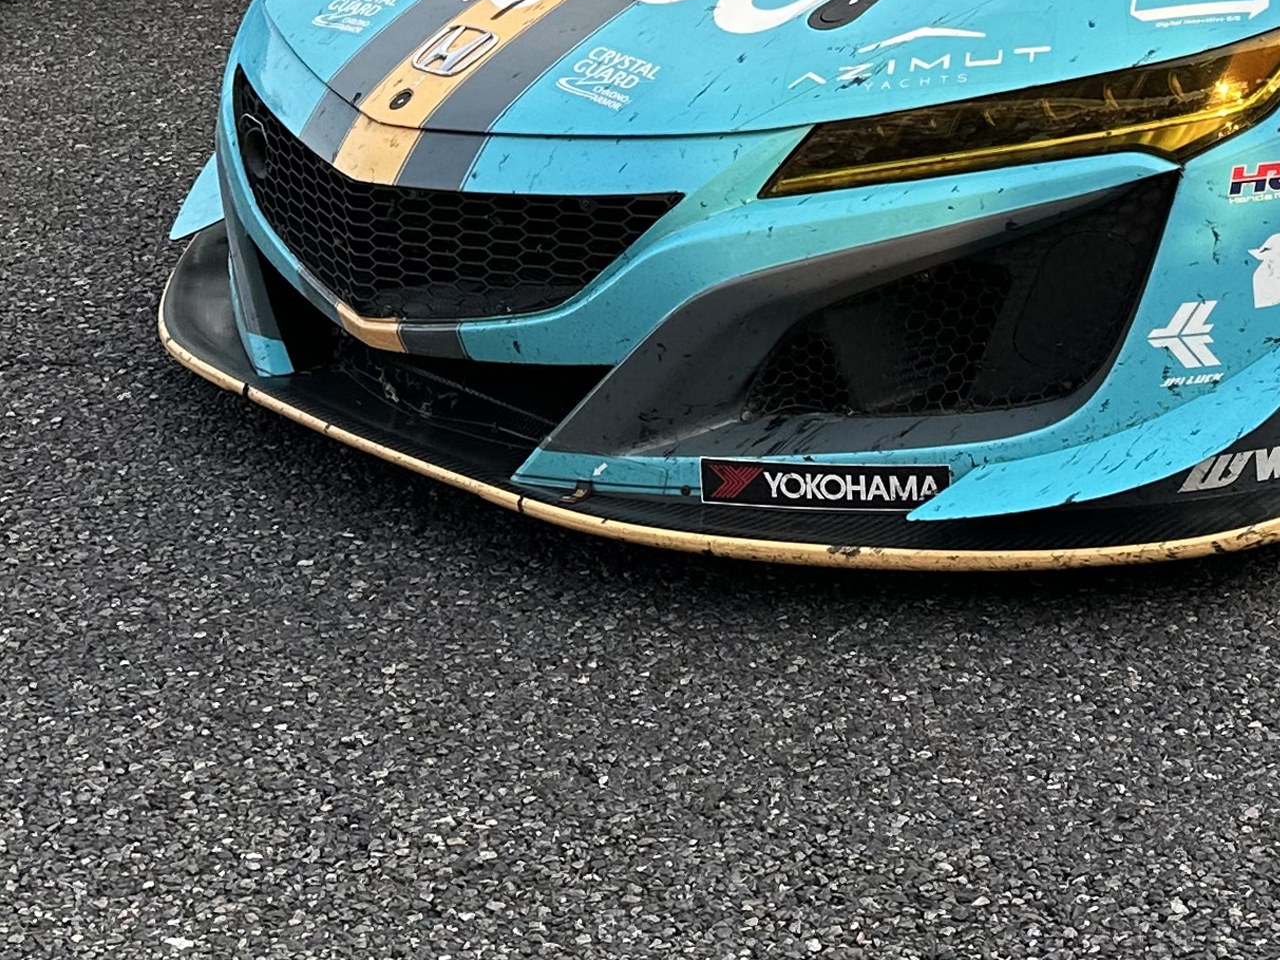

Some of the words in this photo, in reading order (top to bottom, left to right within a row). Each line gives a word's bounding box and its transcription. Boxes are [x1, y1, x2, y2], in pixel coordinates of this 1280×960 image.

[573, 59, 641, 90] GUARD
[588, 46, 661, 81] CRYSTAL
[788, 45, 1052, 89] AZIMUT
[863, 73, 969, 92] YACHTS
[763, 470, 939, 503] YOKOHAMA
